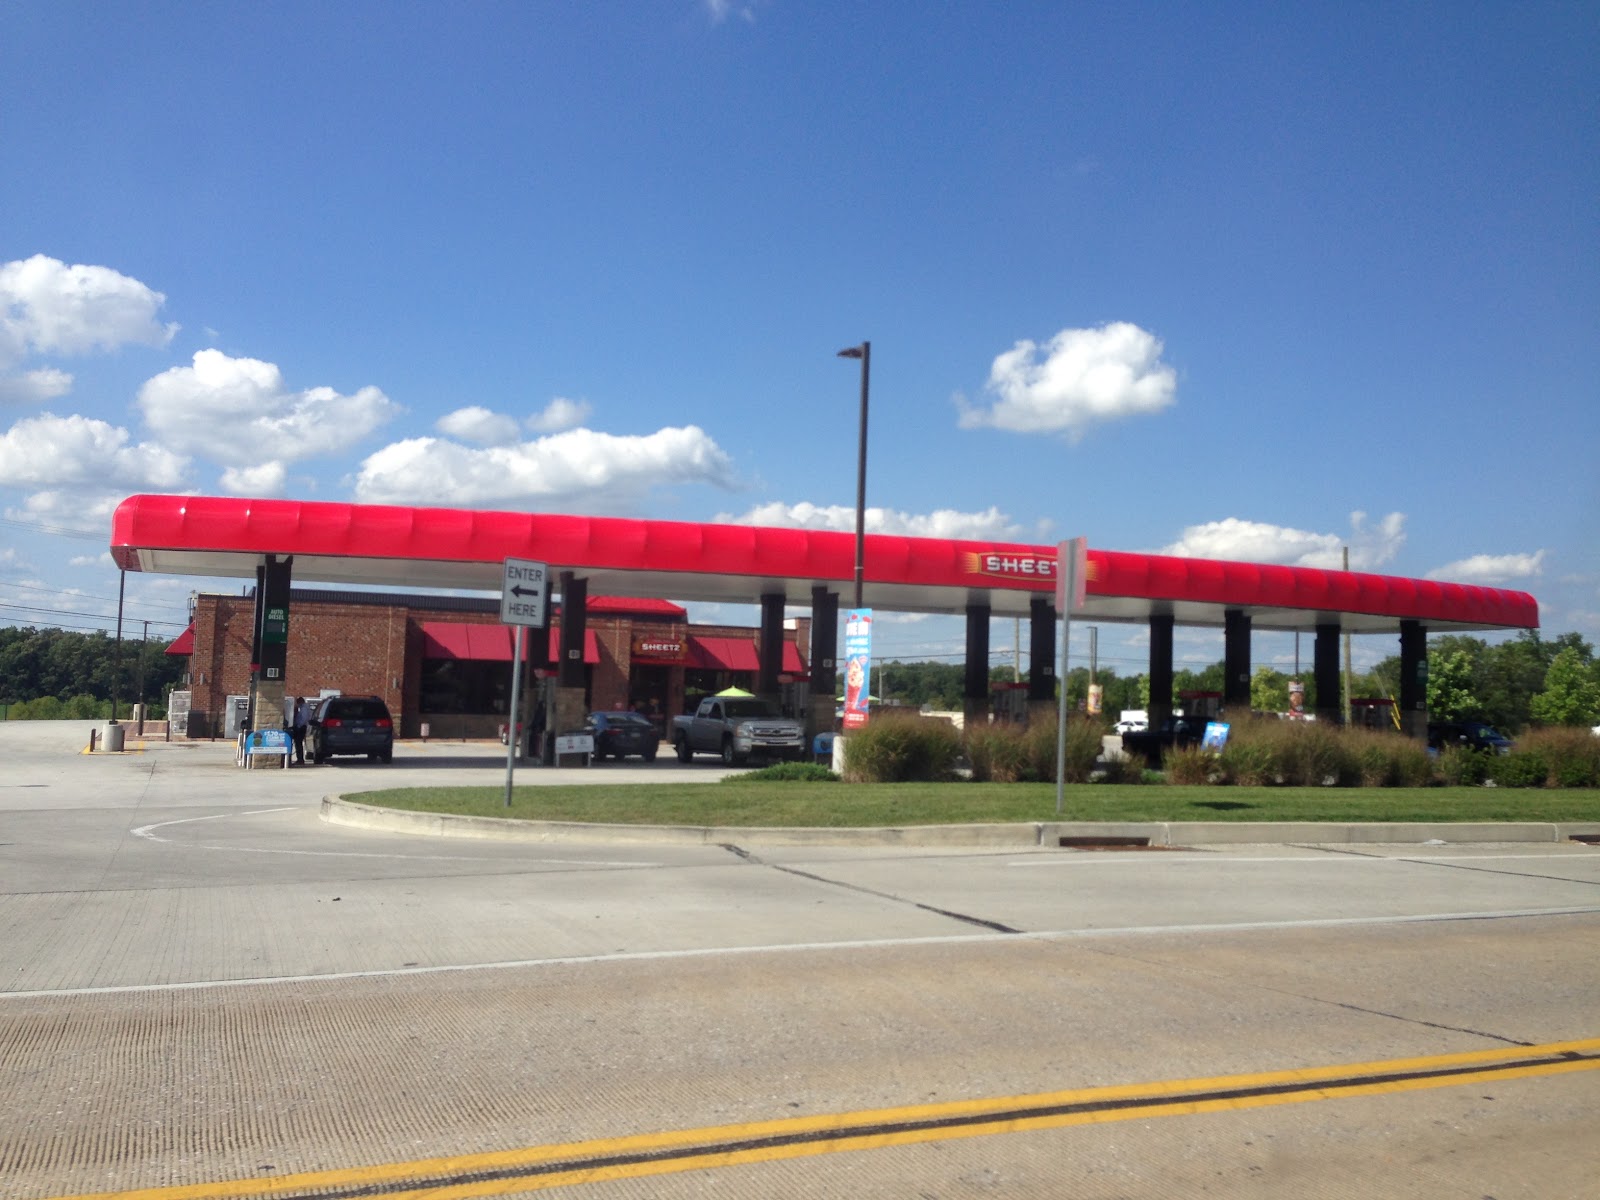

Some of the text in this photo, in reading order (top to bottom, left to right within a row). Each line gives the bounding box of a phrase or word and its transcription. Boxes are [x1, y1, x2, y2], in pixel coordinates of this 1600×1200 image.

[986, 556, 1058, 575] SHEE
[507, 566, 543, 582] ENTER
[508, 602, 537, 617] HERE
[641, 643, 681, 652] SHEETZ
